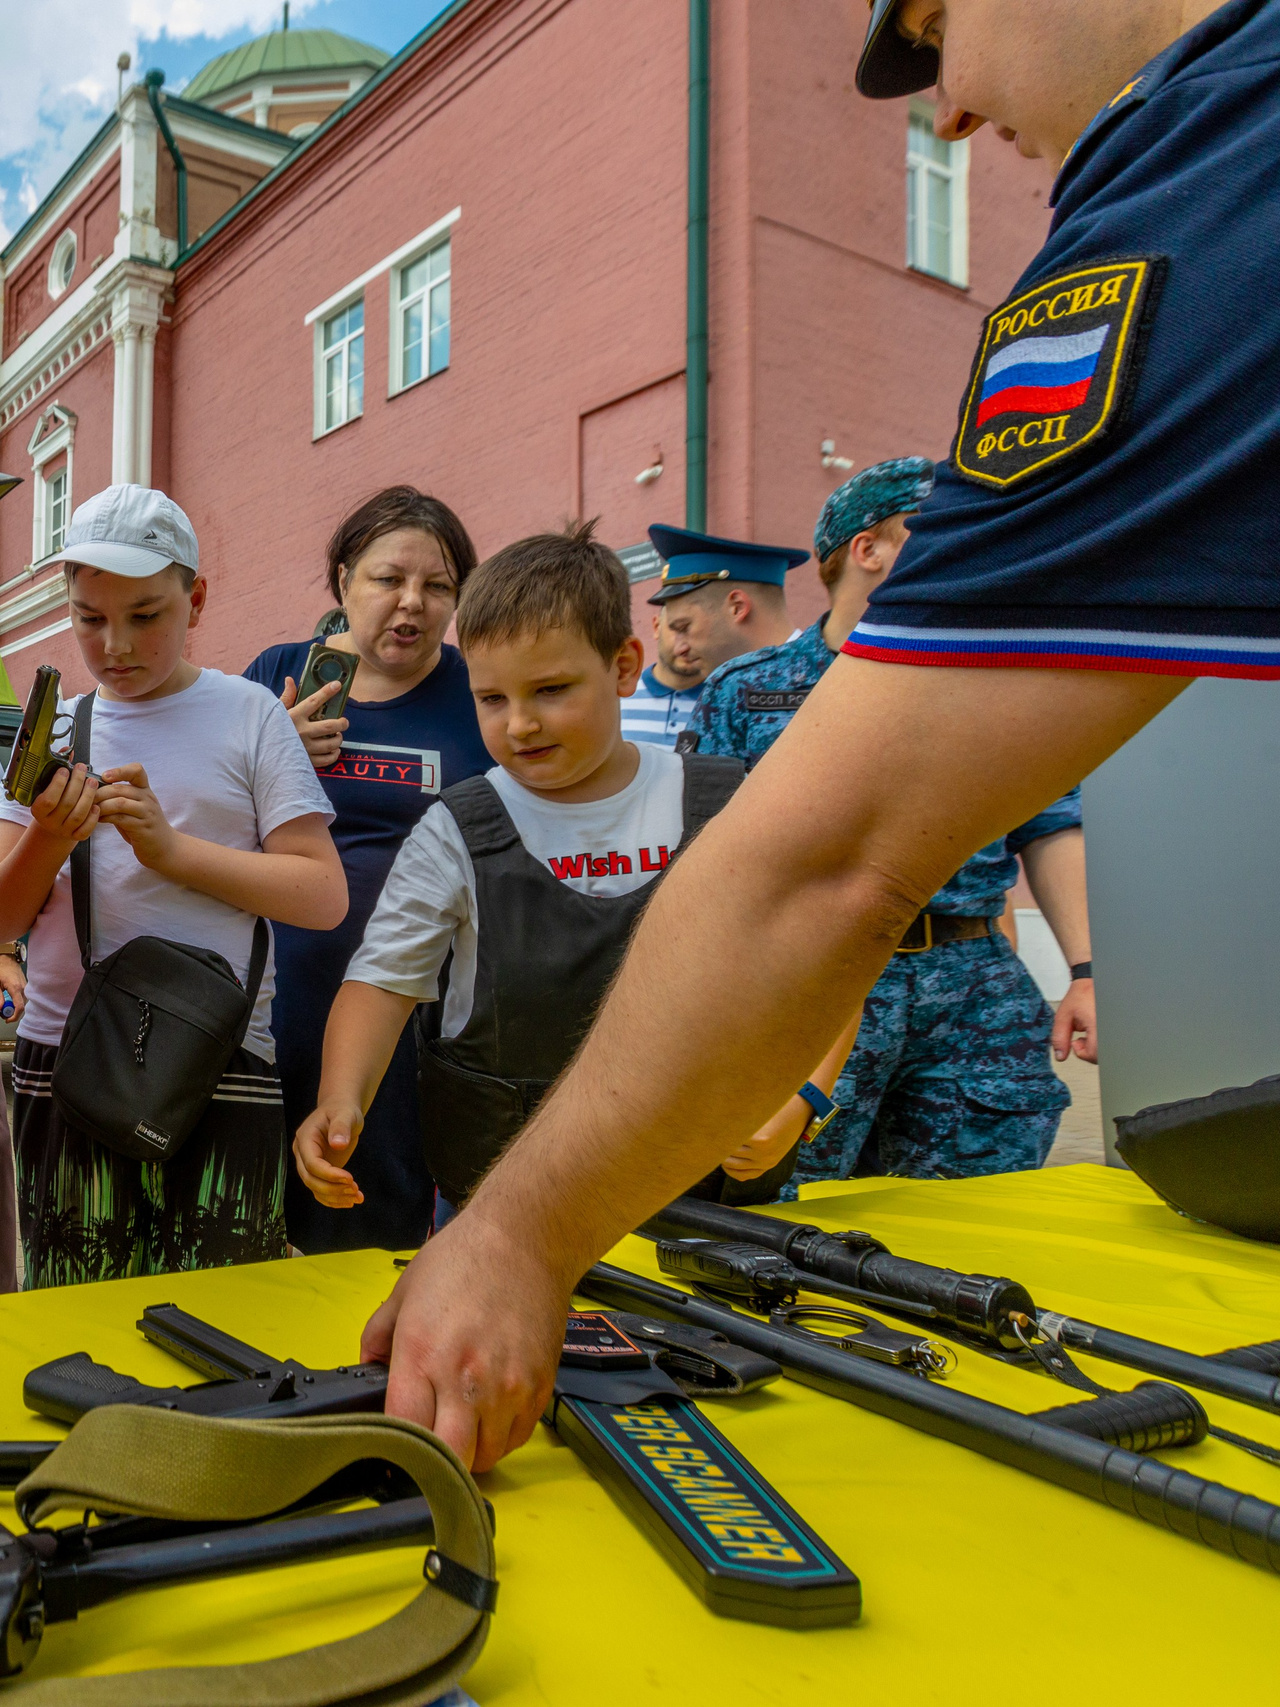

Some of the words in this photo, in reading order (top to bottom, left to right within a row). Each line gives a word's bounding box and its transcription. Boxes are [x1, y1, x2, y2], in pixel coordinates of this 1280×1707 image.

[992, 274, 1128, 345] РОССИЯ
[976, 414, 1071, 459] ФССП
[749, 694, 783, 705] ФССП
[787, 694, 806, 705] РО
[315, 762, 411, 780] AUTY
[548, 851, 632, 880] Wish
[639, 845, 676, 872] Li
[637, 1445, 806, 1564] SCANNER
